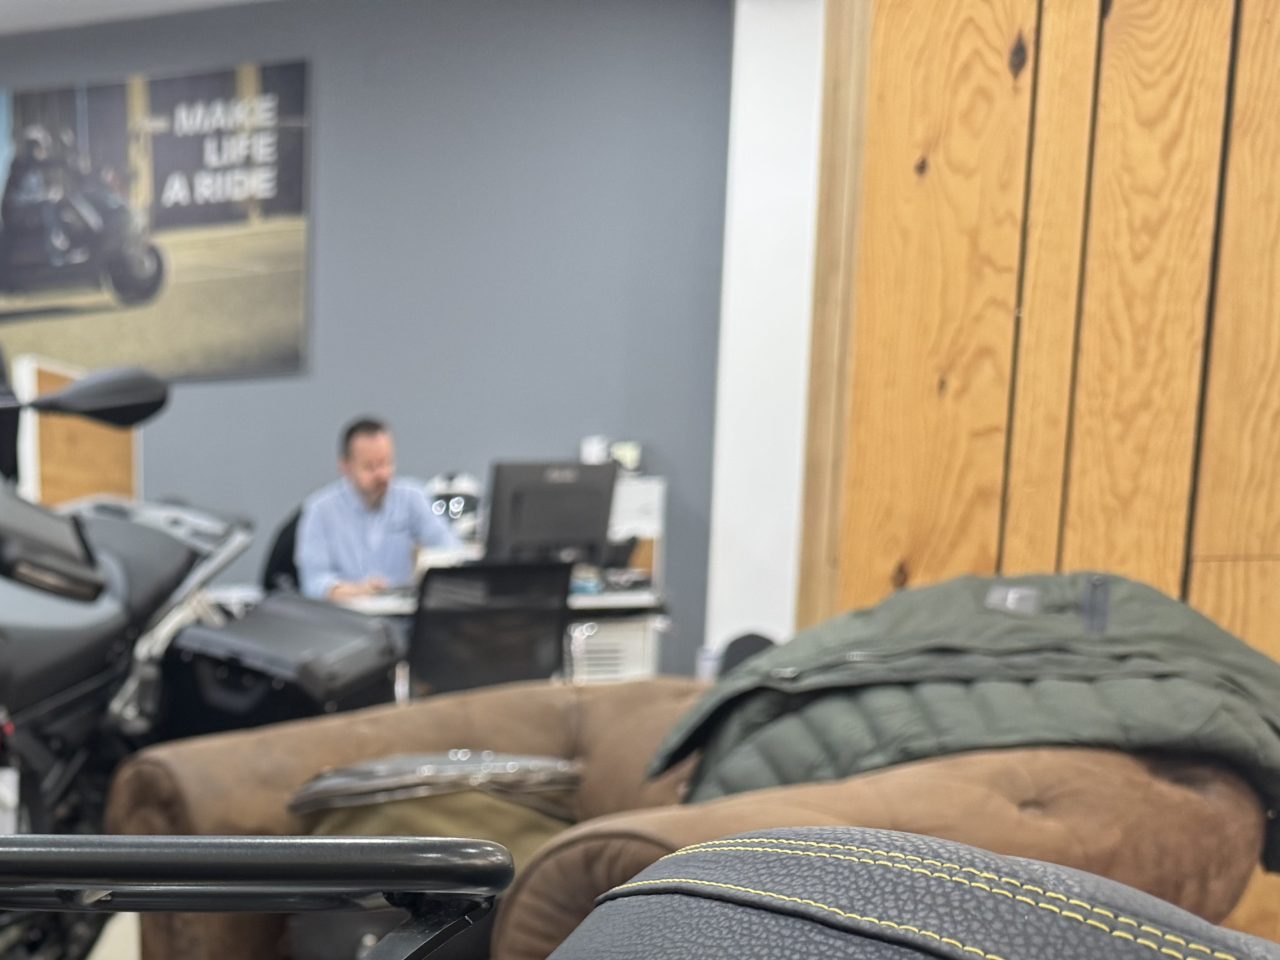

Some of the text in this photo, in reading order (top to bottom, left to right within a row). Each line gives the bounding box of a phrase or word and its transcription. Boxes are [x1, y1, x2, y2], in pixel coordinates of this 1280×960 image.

[174, 94, 278, 136] MAKE
[203, 132, 278, 168] LIFE
[161, 166, 278, 207] A RIDE
